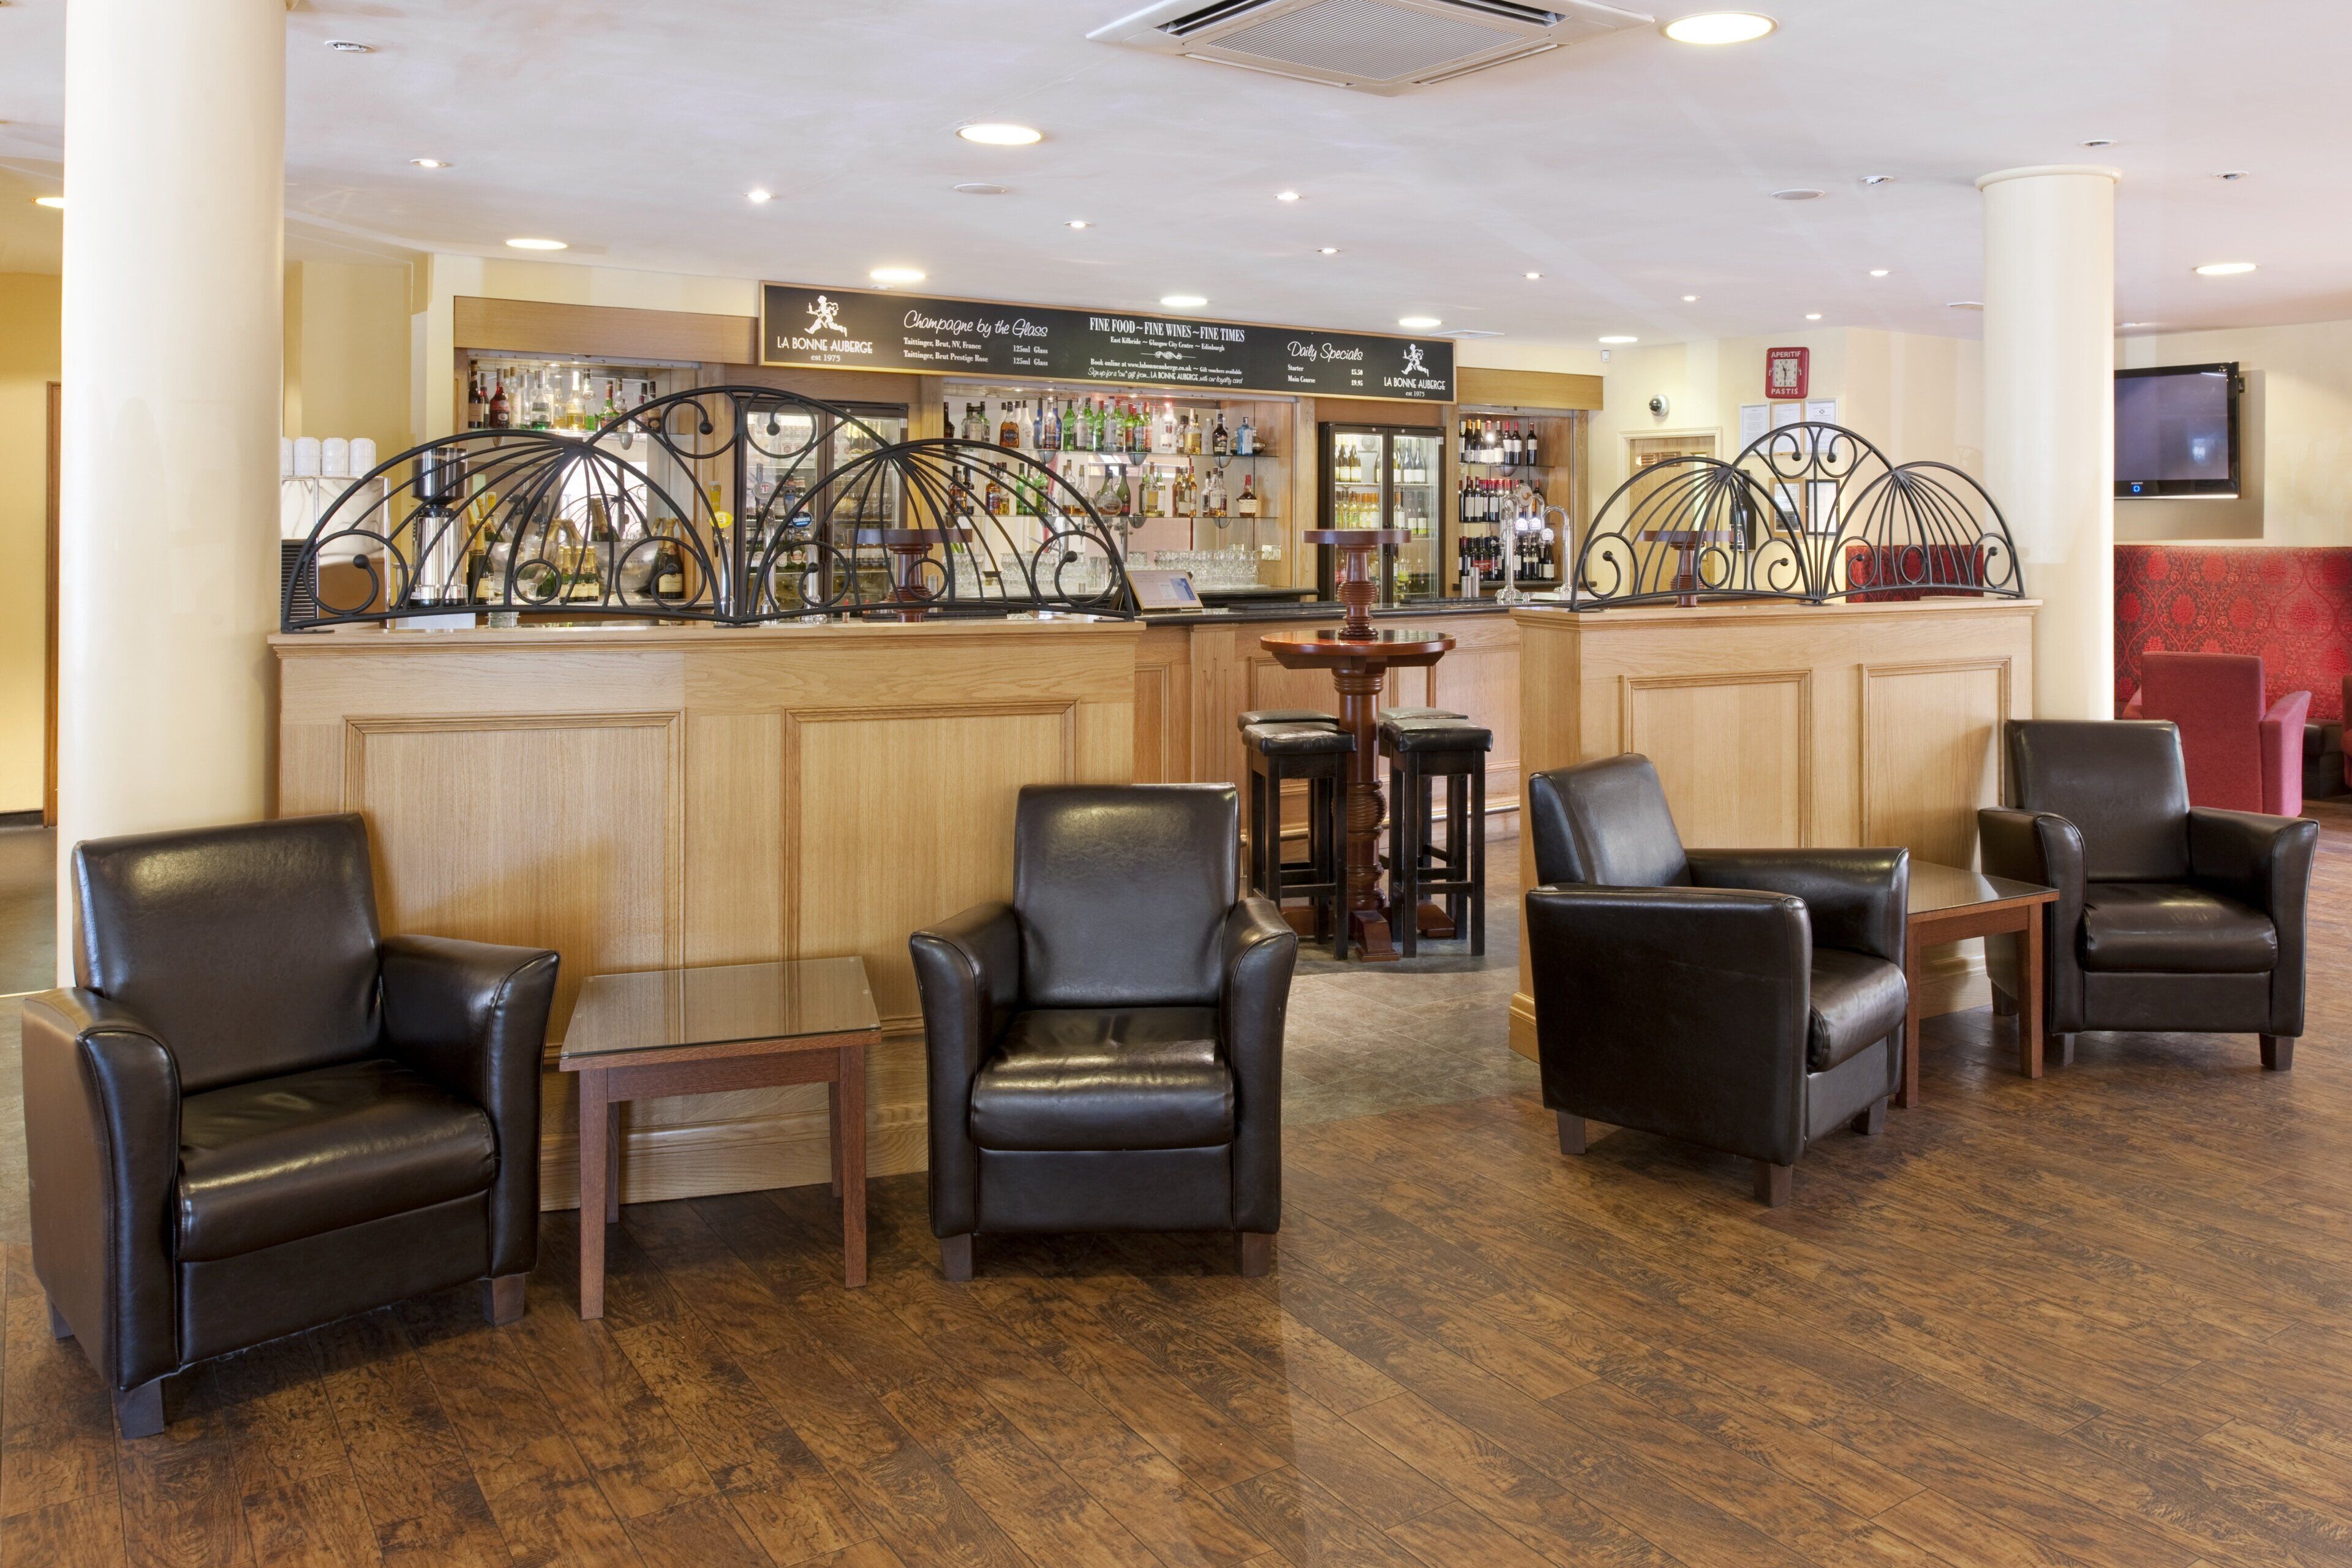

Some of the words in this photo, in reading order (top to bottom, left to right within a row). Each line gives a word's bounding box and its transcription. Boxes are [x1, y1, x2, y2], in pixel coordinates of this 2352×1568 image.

[903, 310, 973, 335] Champagne
[976, 318, 992, 337] by
[995, 320, 1009, 334] the
[1012, 318, 1048, 337] Glass
[1090, 317, 1110, 331] FINE
[1111, 319, 1135, 333] FOOD
[1144, 322, 1164, 336] FINE
[1166, 323, 1191, 338] WINES
[1200, 326, 1219, 340] FINE
[1220, 328, 1245, 342] TIMES
[777, 336, 790, 349] LA
[792, 337, 827, 351] BONNE
[830, 339, 873, 354] AUBERGE
[903, 337, 934, 348] Taittinger,
[935, 339, 951, 349] Brut,
[952, 341, 962, 349] NV,
[962, 341, 982, 350] France
[1149, 339, 1168, 348] Glasgow
[1168, 341, 1177, 349] City
[1201, 343, 1225, 352] Edinburgh
[903, 350, 934, 360] Taittinger,
[950, 353, 974, 363] Prestige
[1287, 341, 1317, 361] Daily
[1321, 343, 1363, 362] Specials
[1128, 361, 1192, 372] www.labonneauberge.co.uk
[1384, 377, 1392, 386] LA
[1393, 377, 1416, 388] BONNE
[1418, 379, 1446, 390] AUBERGE
